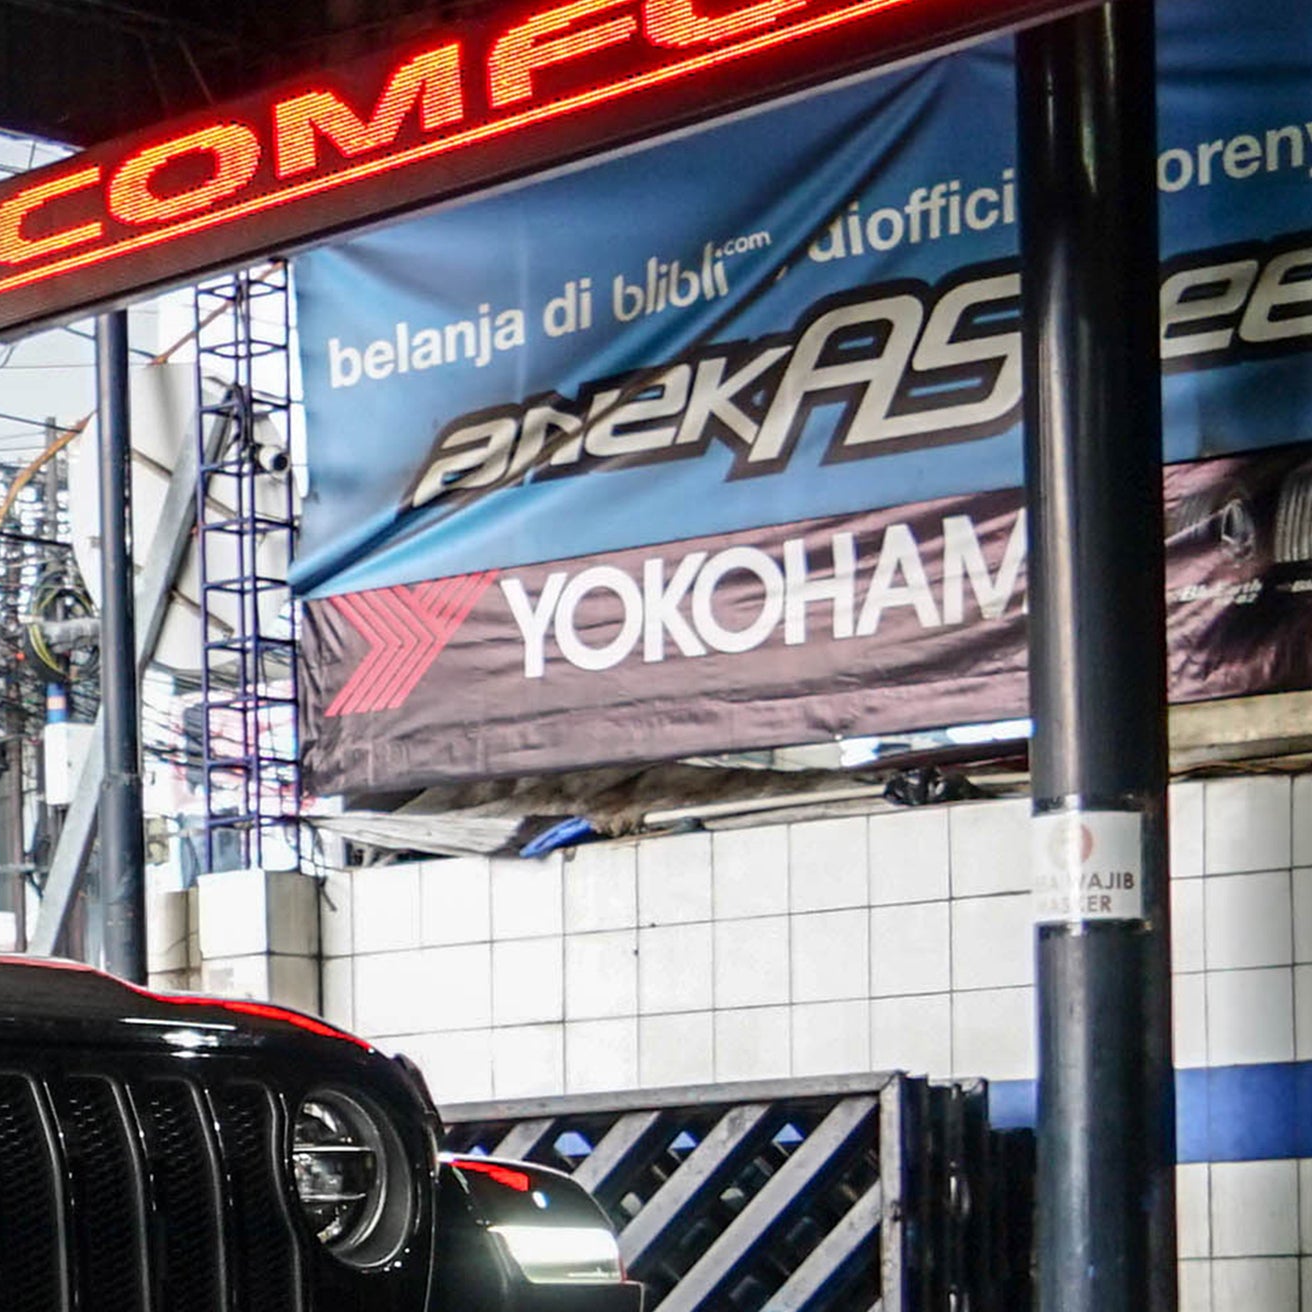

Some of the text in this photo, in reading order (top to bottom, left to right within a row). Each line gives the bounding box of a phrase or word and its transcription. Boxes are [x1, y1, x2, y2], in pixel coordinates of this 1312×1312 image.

[328, 306, 526, 388] belanja
[543, 278, 592, 338] di
[501, 506, 1029, 678] YOKOHAM
